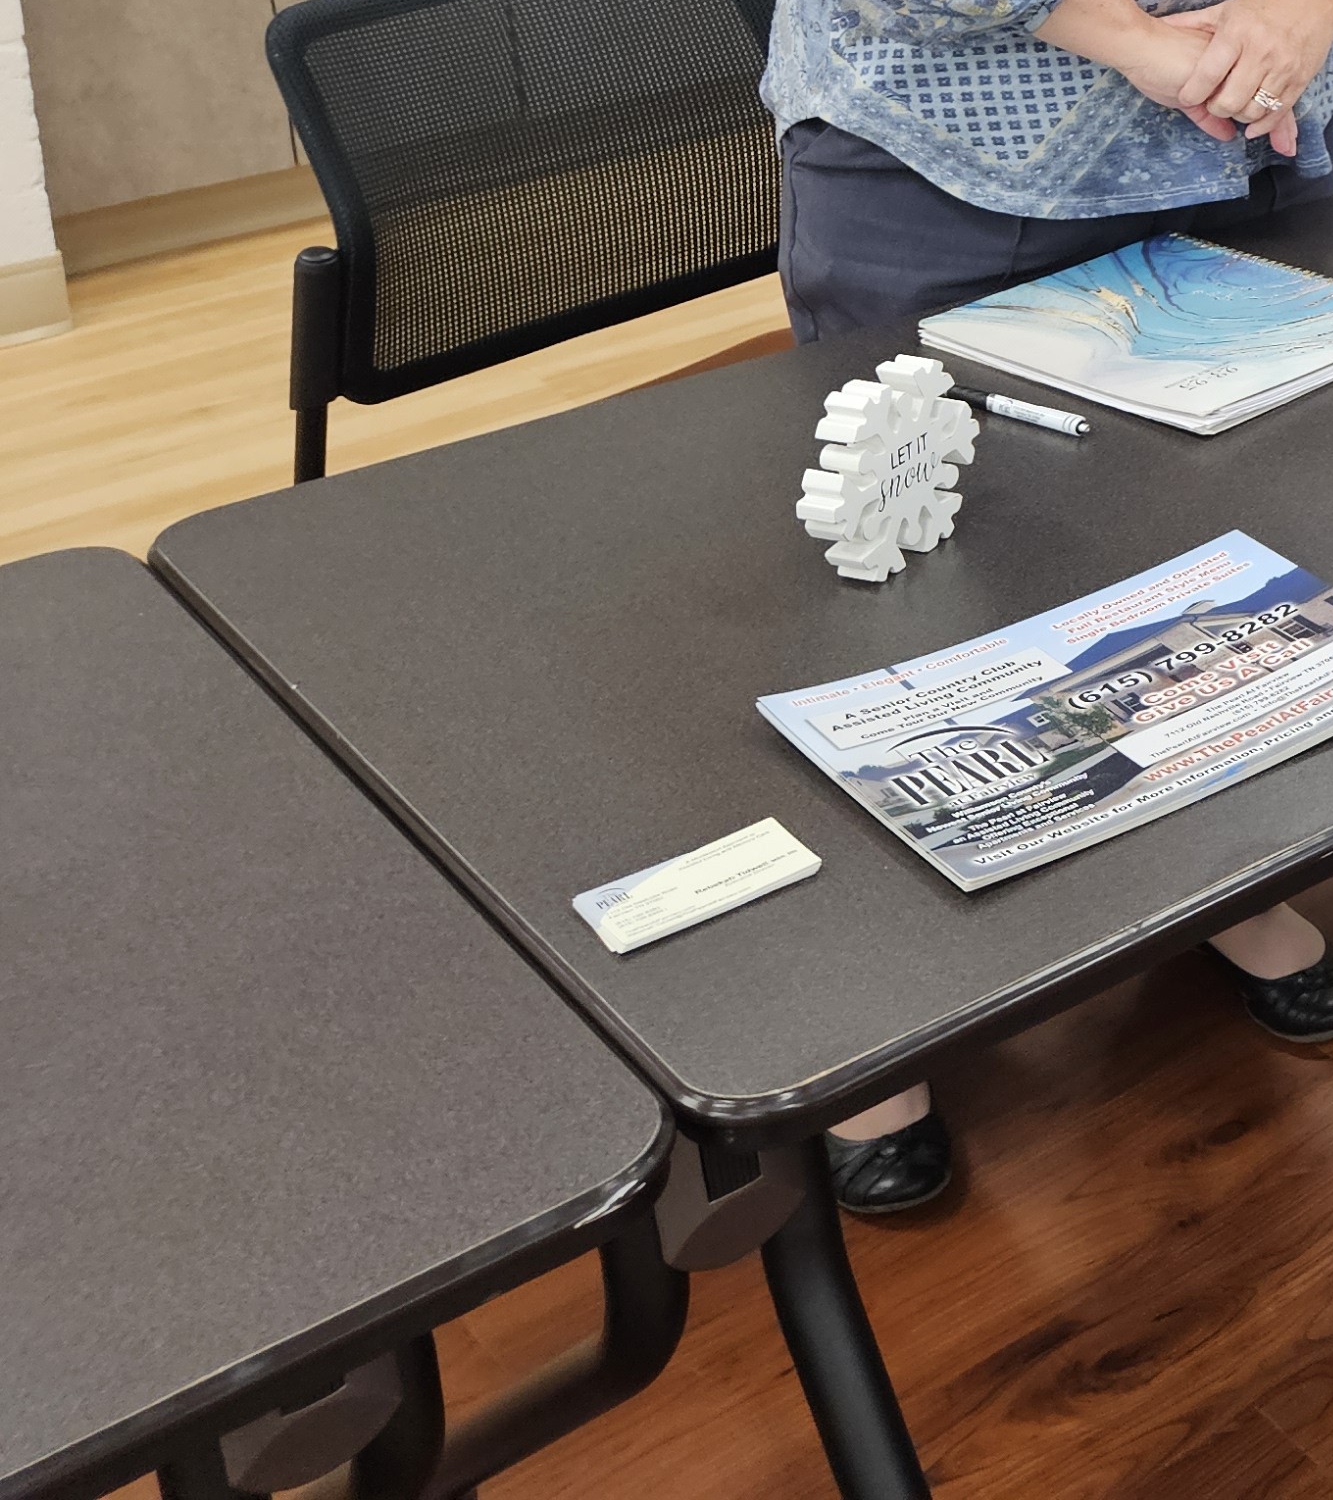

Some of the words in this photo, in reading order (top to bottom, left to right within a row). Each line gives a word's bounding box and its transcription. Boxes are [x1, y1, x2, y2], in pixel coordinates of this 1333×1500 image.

[890, 442, 913, 470] LET
[917, 432, 928, 455] IT
[878, 452, 940, 512] snow
[1049, 608, 1103, 630] Locally
[1098, 589, 1148, 609] Owned
[1143, 578, 1172, 590] and
[1169, 551, 1229, 580] Operated
[1064, 625, 1111, 645] Single
[1105, 601, 1170, 627] Bedroom
[1162, 580, 1215, 602] Private
[1207, 561, 1255, 581] Suites
[1065, 620, 1094, 633] Full
[1090, 592, 1167, 622] Restaurant
[1161, 576, 1201, 593] Style
[1193, 560, 1235, 577] Menu
[790, 683, 851, 711] Intimate
[860, 667, 916, 692] Elegant
[923, 637, 1009, 670] Comfortable
[1063, 668, 1158, 711] (615)
[1153, 602, 1300, 672] 799-8282
[1131, 693, 1195, 723] Give
[1196, 676, 1236, 696] Us
[1235, 665, 1259, 677] A
[1257, 639, 1315, 666] Call
[1140, 670, 1217, 705] Come
[1215, 641, 1283, 671] Visit
[829, 704, 901, 736] Assisted
[903, 690, 955, 713] Living
[954, 658, 1044, 695] Community
[842, 712, 856, 720] A
[858, 693, 913, 717] Senior
[913, 672, 979, 700] Country
[978, 659, 1017, 676] Club
[859, 724, 896, 741] Come
[897, 716, 925, 730] Tour
[926, 709, 949, 720] Our
[950, 699, 978, 712] New
[979, 674, 1045, 702] Community
[902, 709, 930, 722] Plan
[941, 696, 968, 708] Visit
[969, 687, 993, 697] and
[889, 735, 1050, 807] PEARL
[907, 733, 980, 769] The
[947, 797, 966, 808] at
[966, 769, 1039, 804] Fairview
[950, 792, 1010, 821] Williamson
[1007, 778, 1053, 800] County's
[965, 819, 1010, 842] Assisted
[1008, 808, 1043, 827] Living
[1039, 787, 1097, 816] Community
[967, 819, 990, 832] The
[989, 810, 1016, 825] Pearl
[1025, 791, 1068, 812] Fairview
[973, 846, 1013, 868] Visit
[1015, 835, 1047, 852] Our
[1045, 812, 1110, 839] Website
[1111, 801, 1135, 814] for
[1135, 784, 1175, 804] More
[1175, 744, 1264, 787] Information,
[1261, 720, 1316, 747] Pricing
[999, 792, 1034, 811] Living
[1030, 770, 1090, 799] Community
[975, 822, 1036, 853] Apartments
[1033, 818, 1053, 830] and
[1052, 801, 1097, 823] Services
[981, 821, 1025, 844] Offering
[1021, 800, 1080, 829] Exceptional
